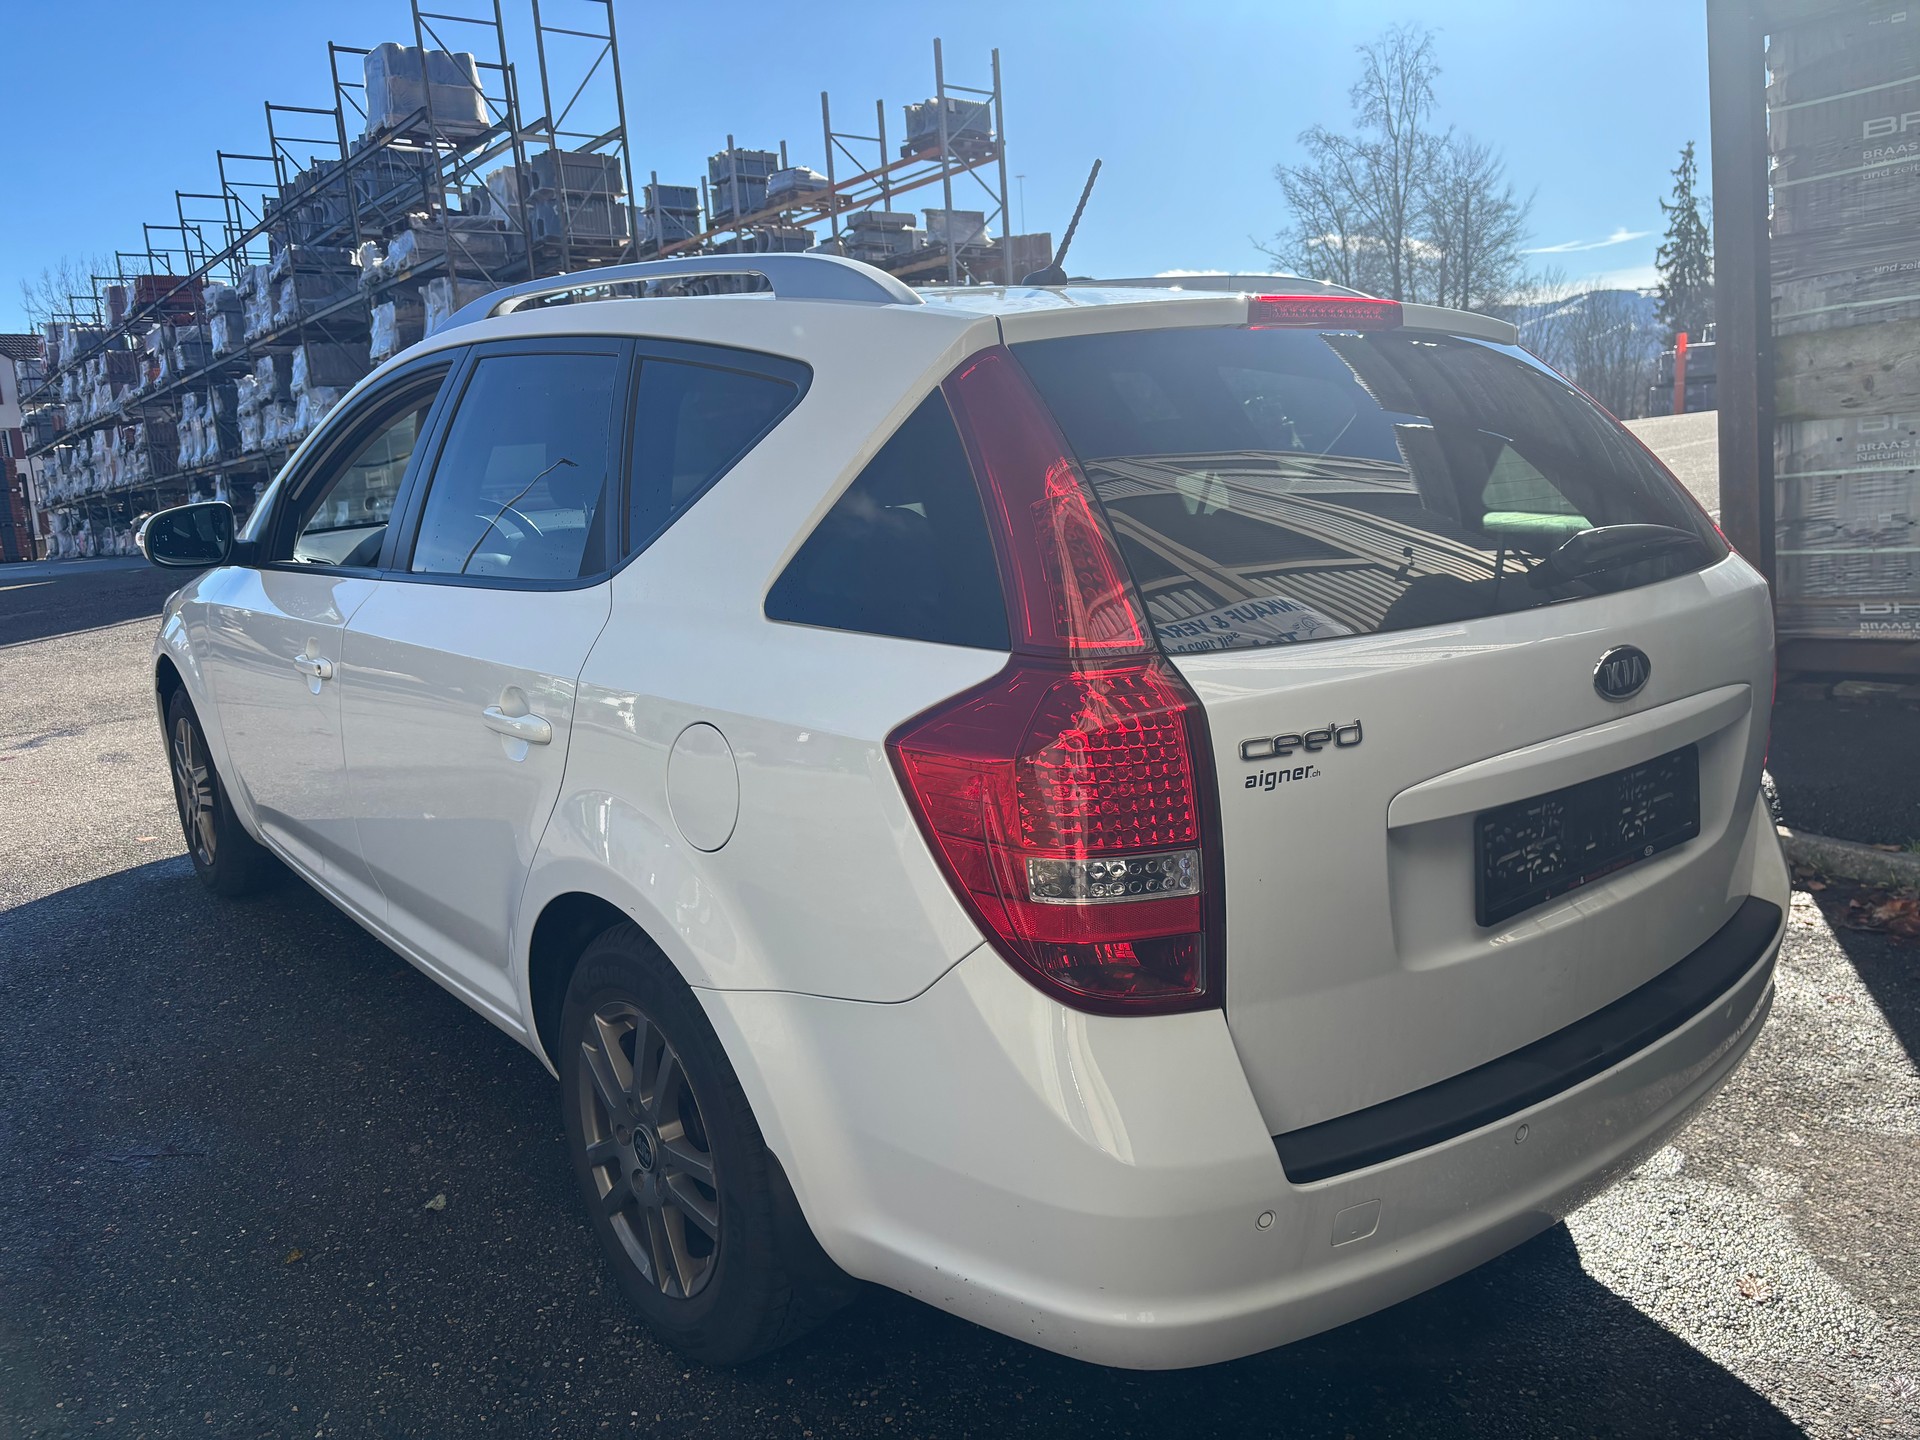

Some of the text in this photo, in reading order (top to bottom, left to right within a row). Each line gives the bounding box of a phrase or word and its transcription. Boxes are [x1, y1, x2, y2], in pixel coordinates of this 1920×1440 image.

[1862, 141, 1919, 159] BRAAS
[1862, 167, 1890, 180] und
[1857, 439, 1911, 452] BRAAS
[1604, 655, 1645, 691] KIA
[1244, 764, 1321, 792] aigner.ch
